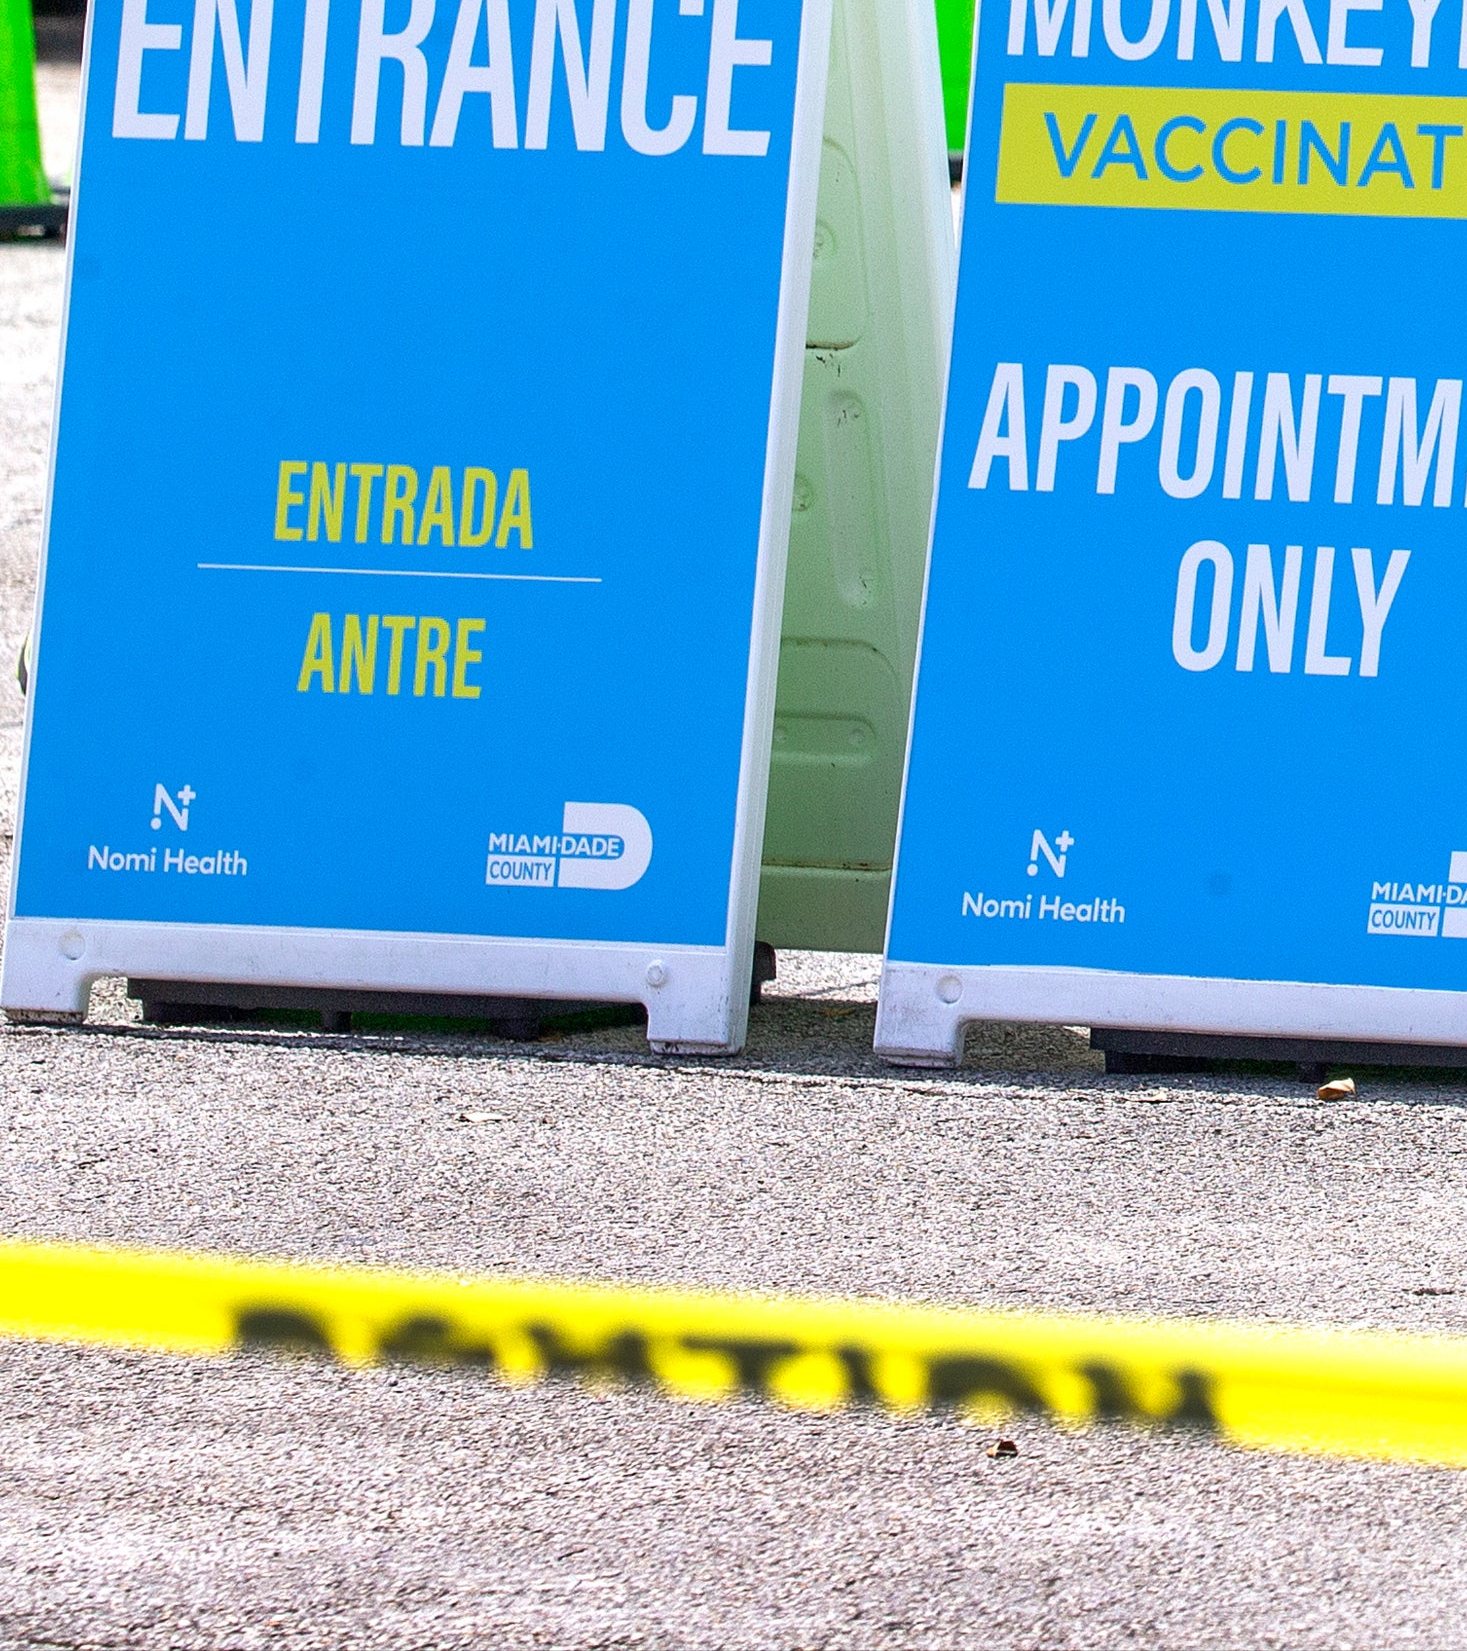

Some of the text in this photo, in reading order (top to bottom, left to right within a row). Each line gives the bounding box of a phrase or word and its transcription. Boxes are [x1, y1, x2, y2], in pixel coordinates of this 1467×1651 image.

[274, 460, 534, 549] ENTRADA
[1172, 540, 1411, 677] ONLY
[297, 612, 486, 699] ANTRE
[88, 845, 248, 876] Nomi Health
[490, 860, 552, 881] COUNTY
[962, 891, 1126, 923] Nomi Health
[1371, 909, 1437, 930] COUNTY
